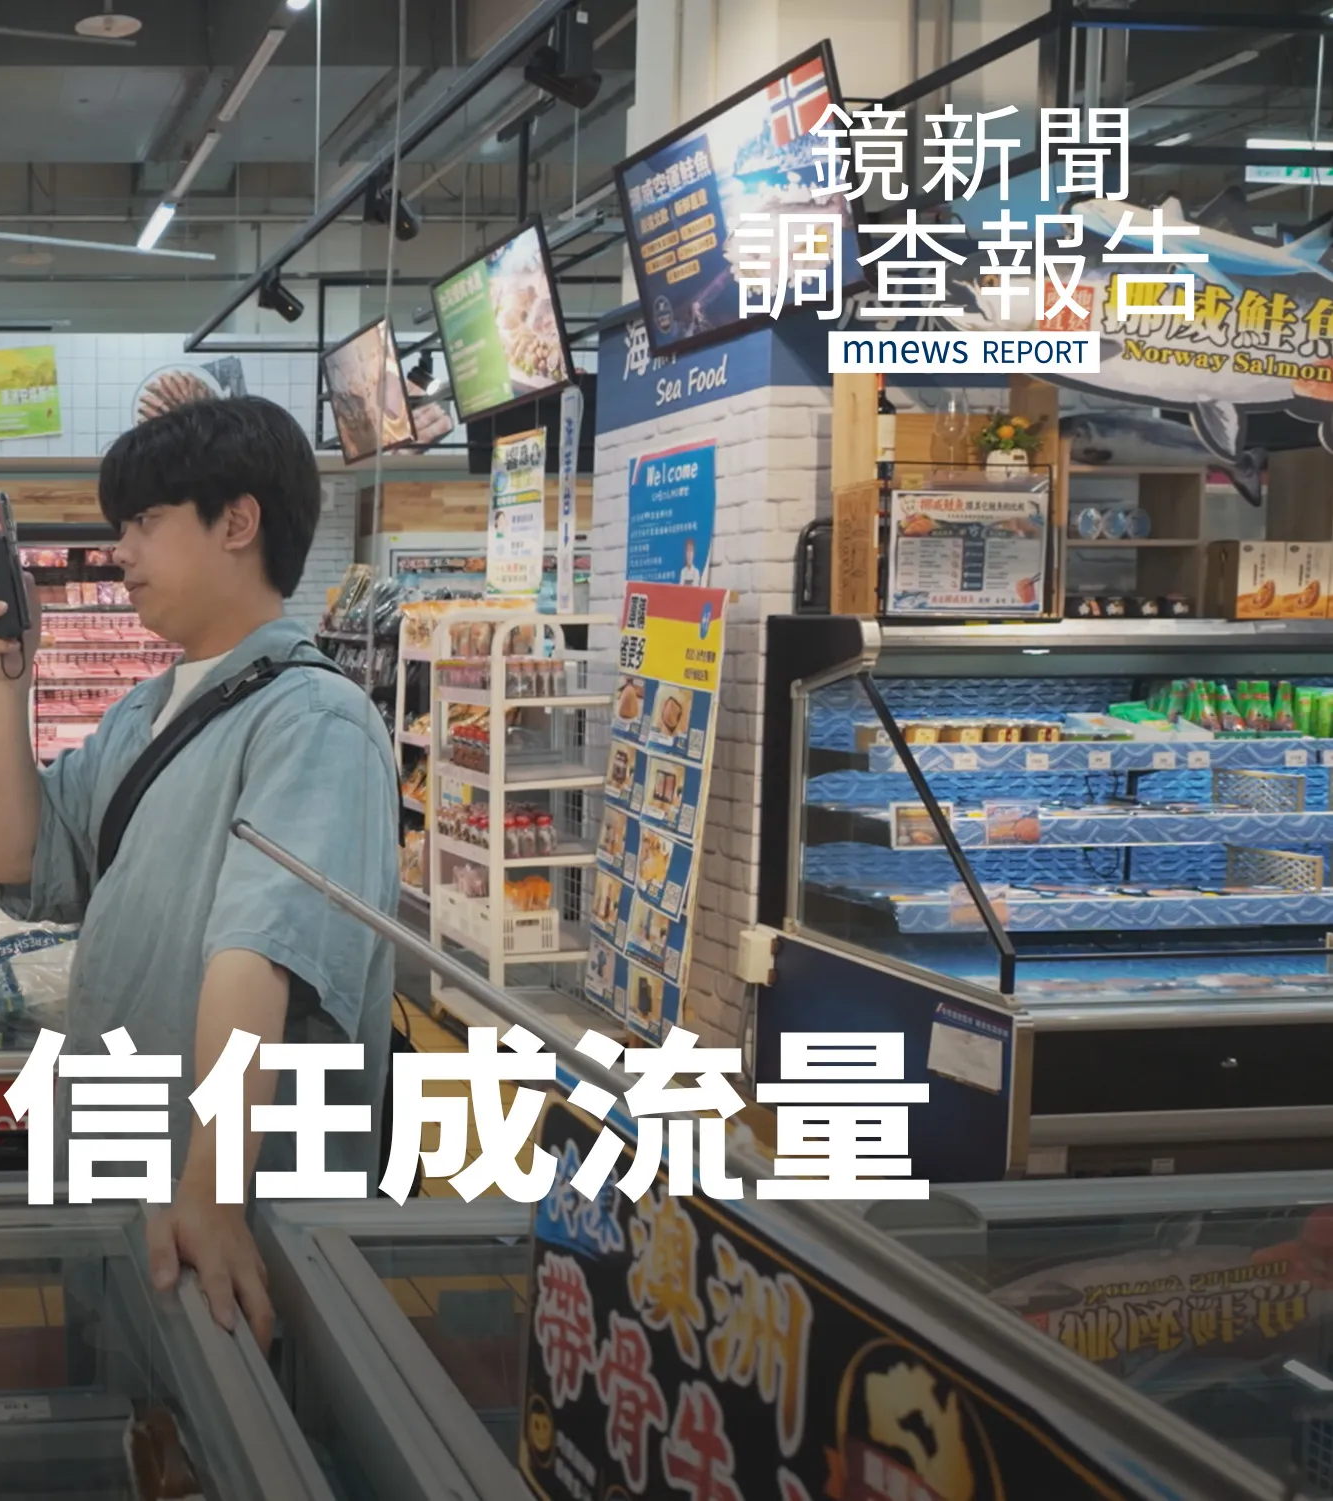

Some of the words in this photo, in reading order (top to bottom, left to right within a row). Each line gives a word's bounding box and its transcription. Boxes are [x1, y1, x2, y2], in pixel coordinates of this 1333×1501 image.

[655, 377, 682, 407] Sea
[687, 352, 728, 397] Food
[1123, 339, 1228, 373] Norway
[1233, 350, 1332, 383] Salmon
[646, 461, 699, 488] Welcome
